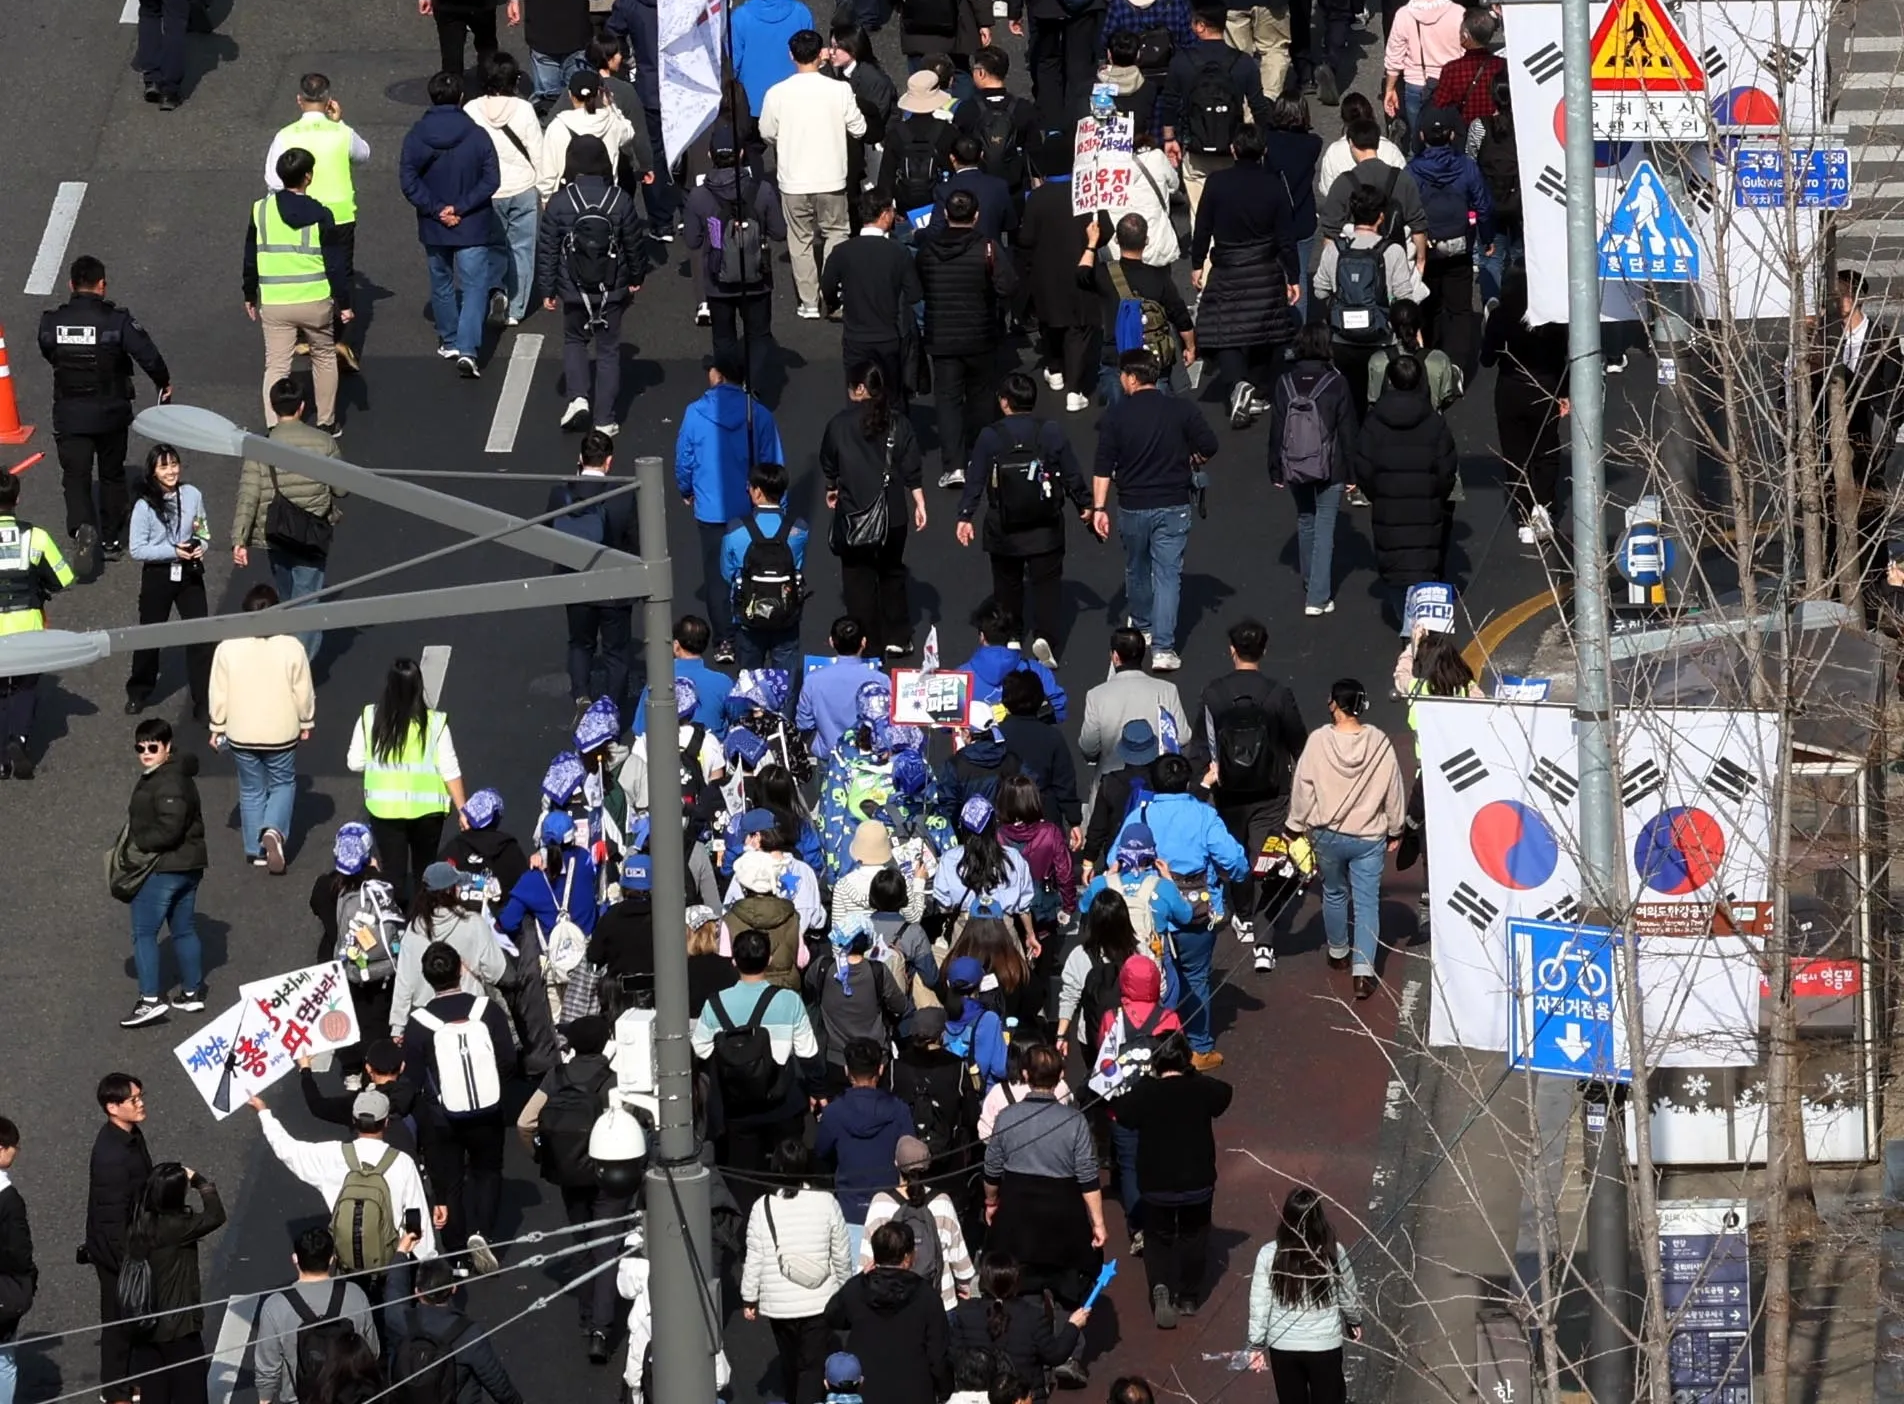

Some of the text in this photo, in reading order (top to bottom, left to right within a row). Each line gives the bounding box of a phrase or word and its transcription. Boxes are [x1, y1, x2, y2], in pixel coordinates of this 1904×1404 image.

[1738, 153, 1817, 173] 국회로
[1607, 255, 1688, 273] 횡단보도
[926, 694, 958, 713] 파면
[1535, 995, 1611, 1022] 자전거전용
[1493, 1378, 1514, 1403] 한
